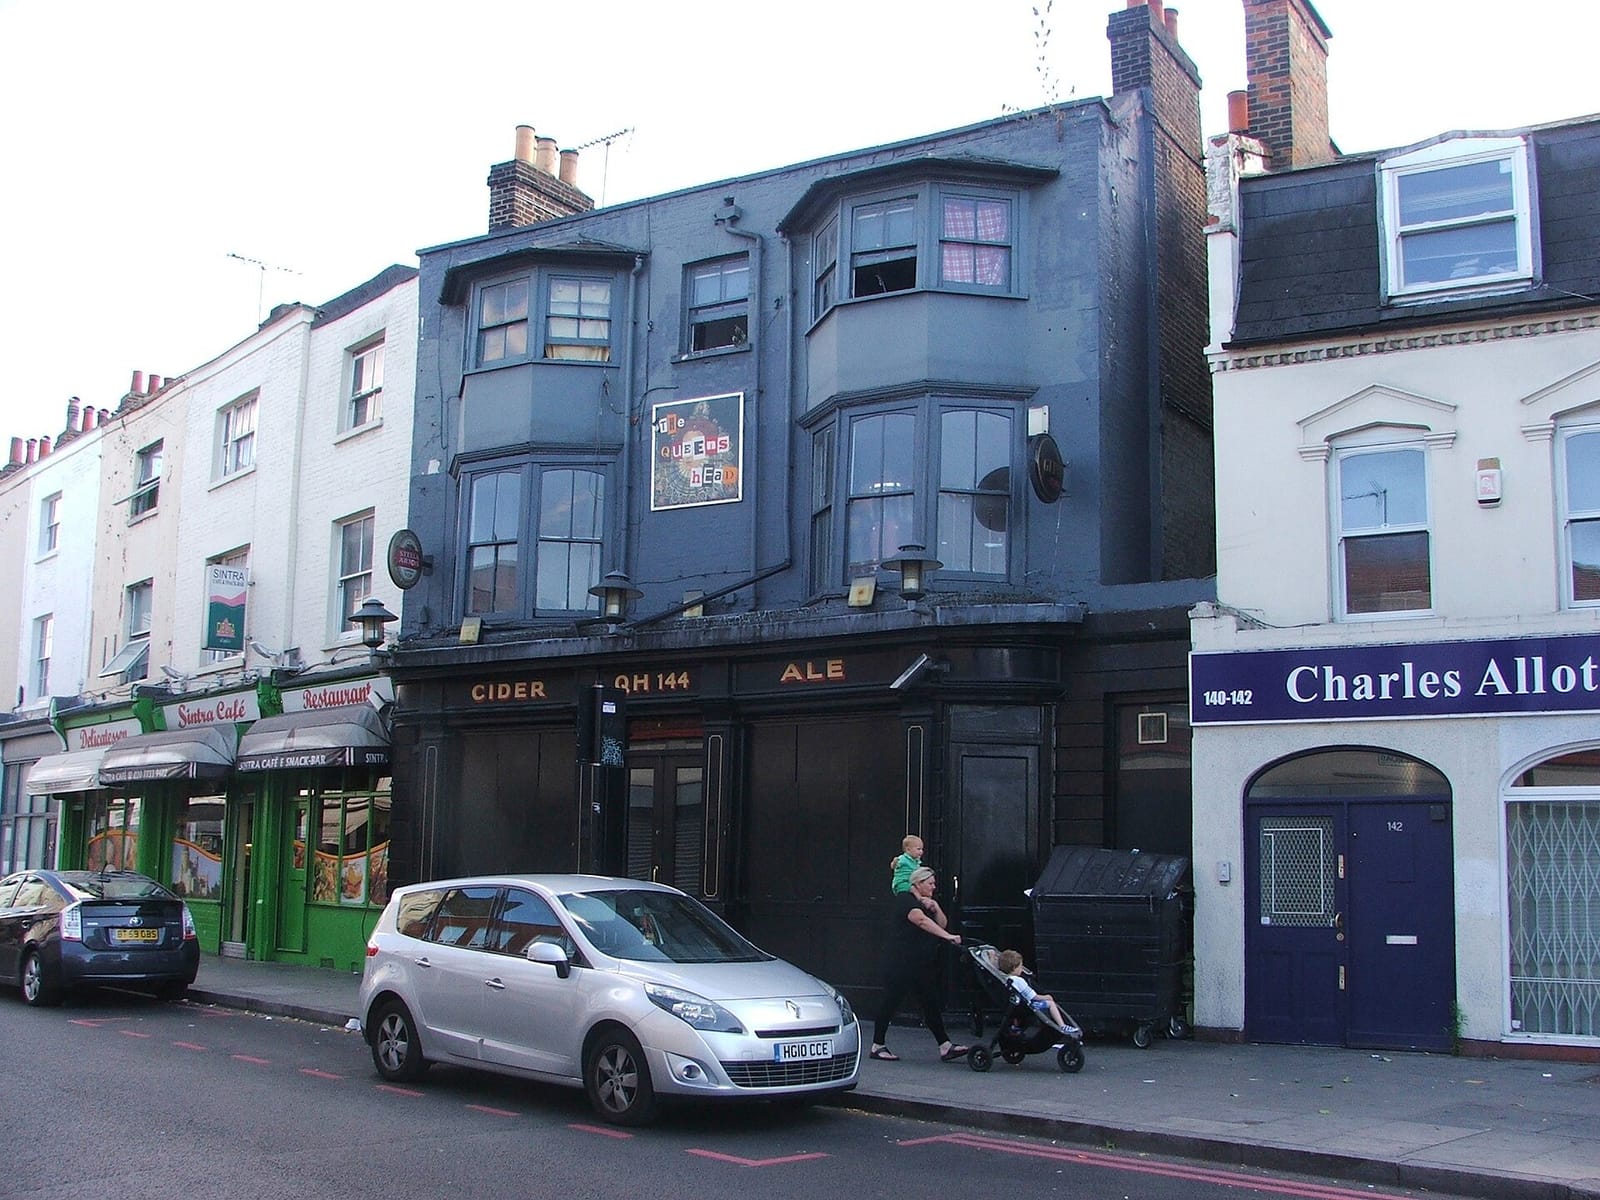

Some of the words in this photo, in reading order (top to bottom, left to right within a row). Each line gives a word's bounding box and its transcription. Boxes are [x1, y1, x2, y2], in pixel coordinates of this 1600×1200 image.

[213, 568, 245, 581] SINTRA
[781, 658, 845, 683] ALE
[471, 680, 546, 701] CIDER
[614, 674, 649, 696] QH
[657, 671, 690, 690] 144
[1285, 659, 1462, 704] Charles
[302, 681, 372, 710] Restaurant
[1203, 689, 1253, 706] 140-142
[178, 704, 214, 728] Sintra
[216, 699, 246, 721] Café
[285, 754, 327, 767] SNACK-BAR
[1386, 821, 1404, 833] 142
[809, 1041, 828, 1056] CCE
